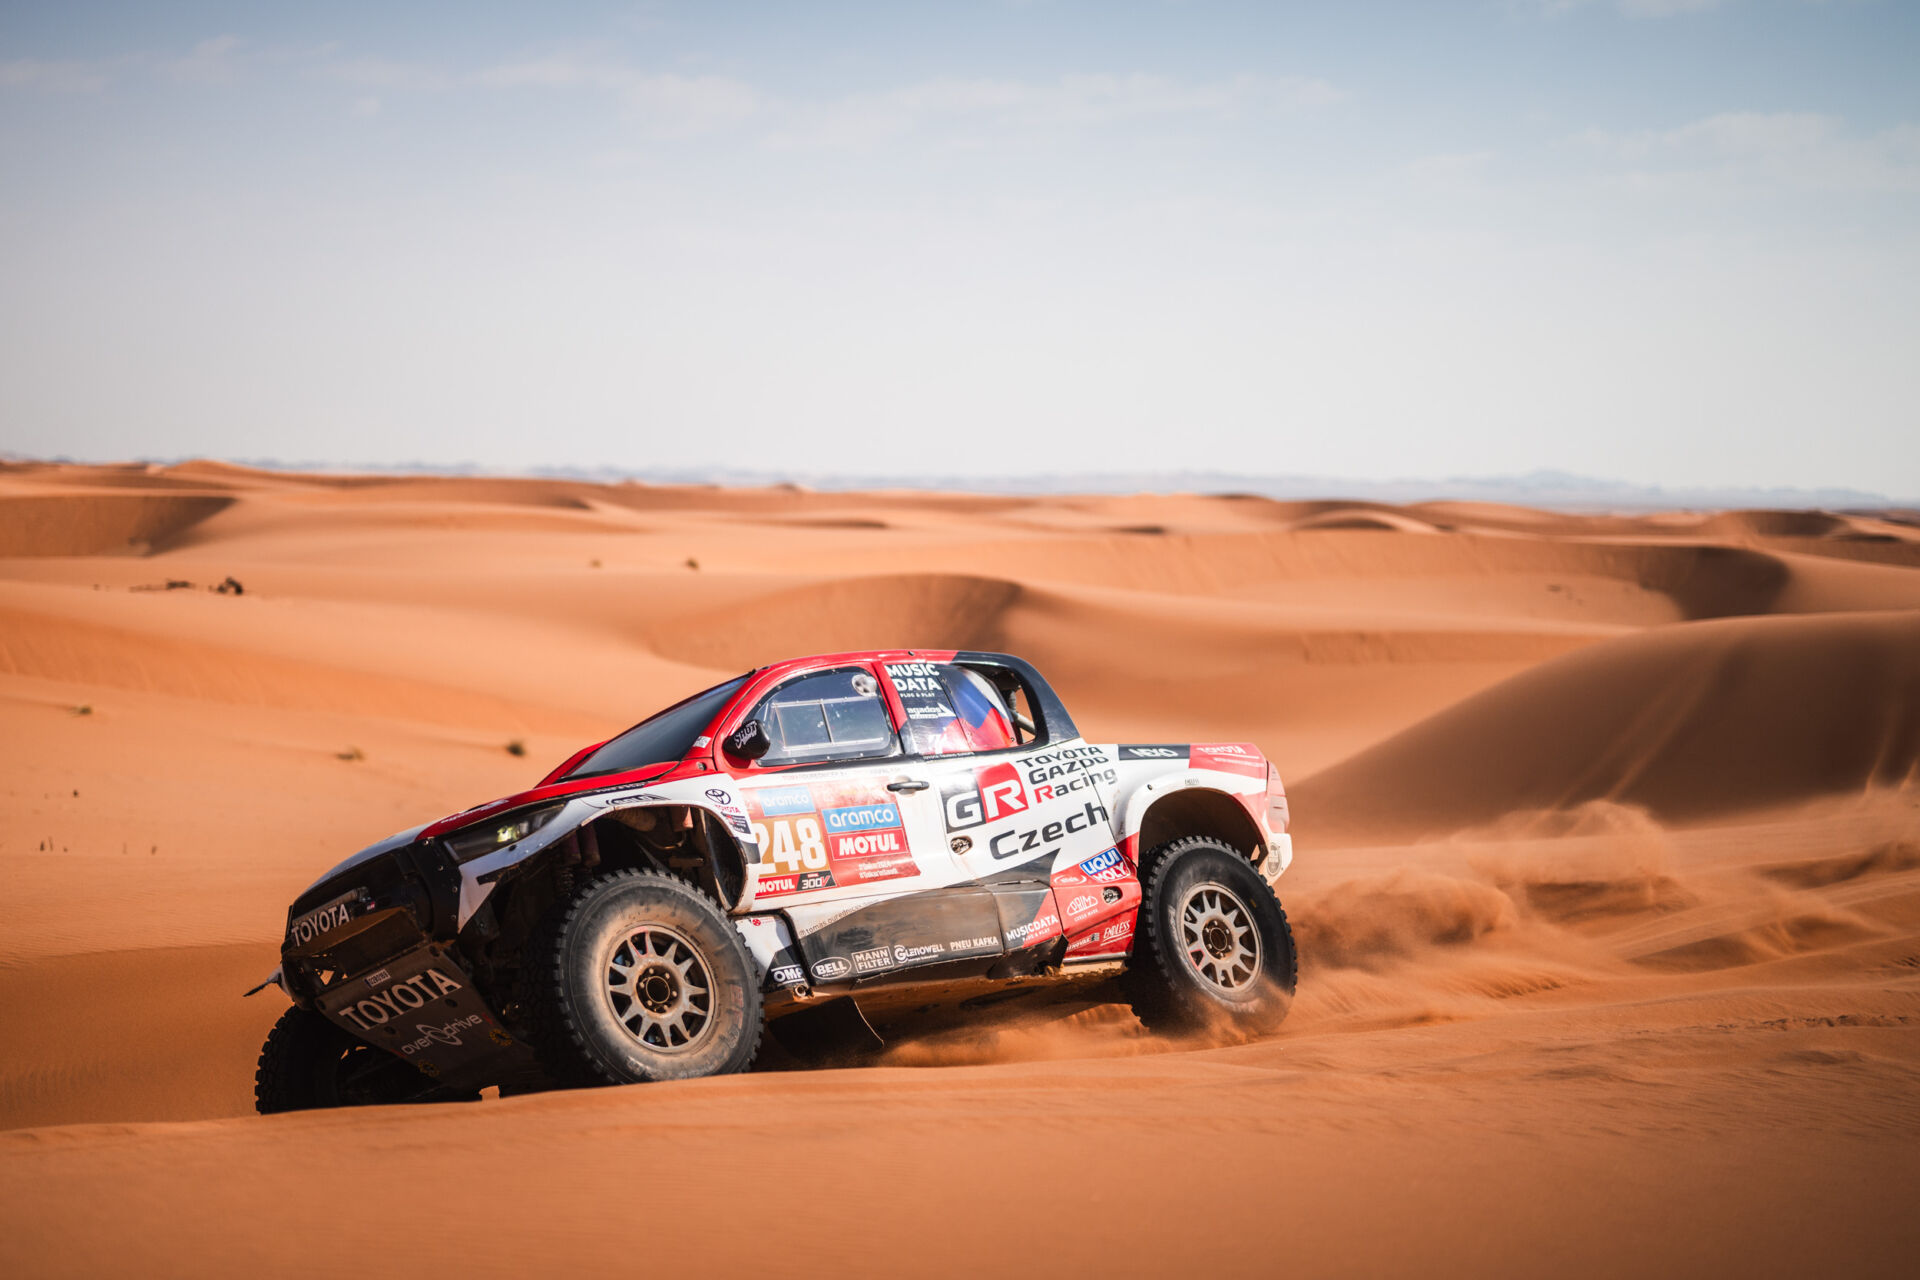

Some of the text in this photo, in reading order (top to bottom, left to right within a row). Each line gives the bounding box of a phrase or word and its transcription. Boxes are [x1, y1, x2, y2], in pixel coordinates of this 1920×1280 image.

[884, 663, 940, 677] MUSIC
[892, 677, 943, 691] DATA
[1016, 746, 1103, 768] TOYOTA
[1029, 756, 1109, 785] GAZOO
[1034, 768, 1118, 803] Racing
[763, 792, 810, 807] aramco
[946, 779, 1026, 828] GR
[829, 808, 895, 827] aramco
[990, 802, 1109, 860] Czech
[755, 818, 827, 874] 248
[839, 833, 900, 857] MOTUL
[1081, 849, 1122, 875] LIQUI
[1092, 862, 1128, 882] MOLY
[756, 878, 796, 893] MOTUL
[801, 875, 832, 890] 300V
[291, 903, 351, 947] TOYOTA
[1006, 914, 1059, 941] MUSICDATA
[1103, 920, 1131, 939] ENDLESS
[950, 936, 999, 951] PNEU KAFKA
[856, 948, 889, 962] MANN
[858, 957, 892, 971] FILTER
[773, 966, 804, 982] OMP
[815, 960, 847, 976] BELL
[338, 969, 463, 1030] TOYOTA
